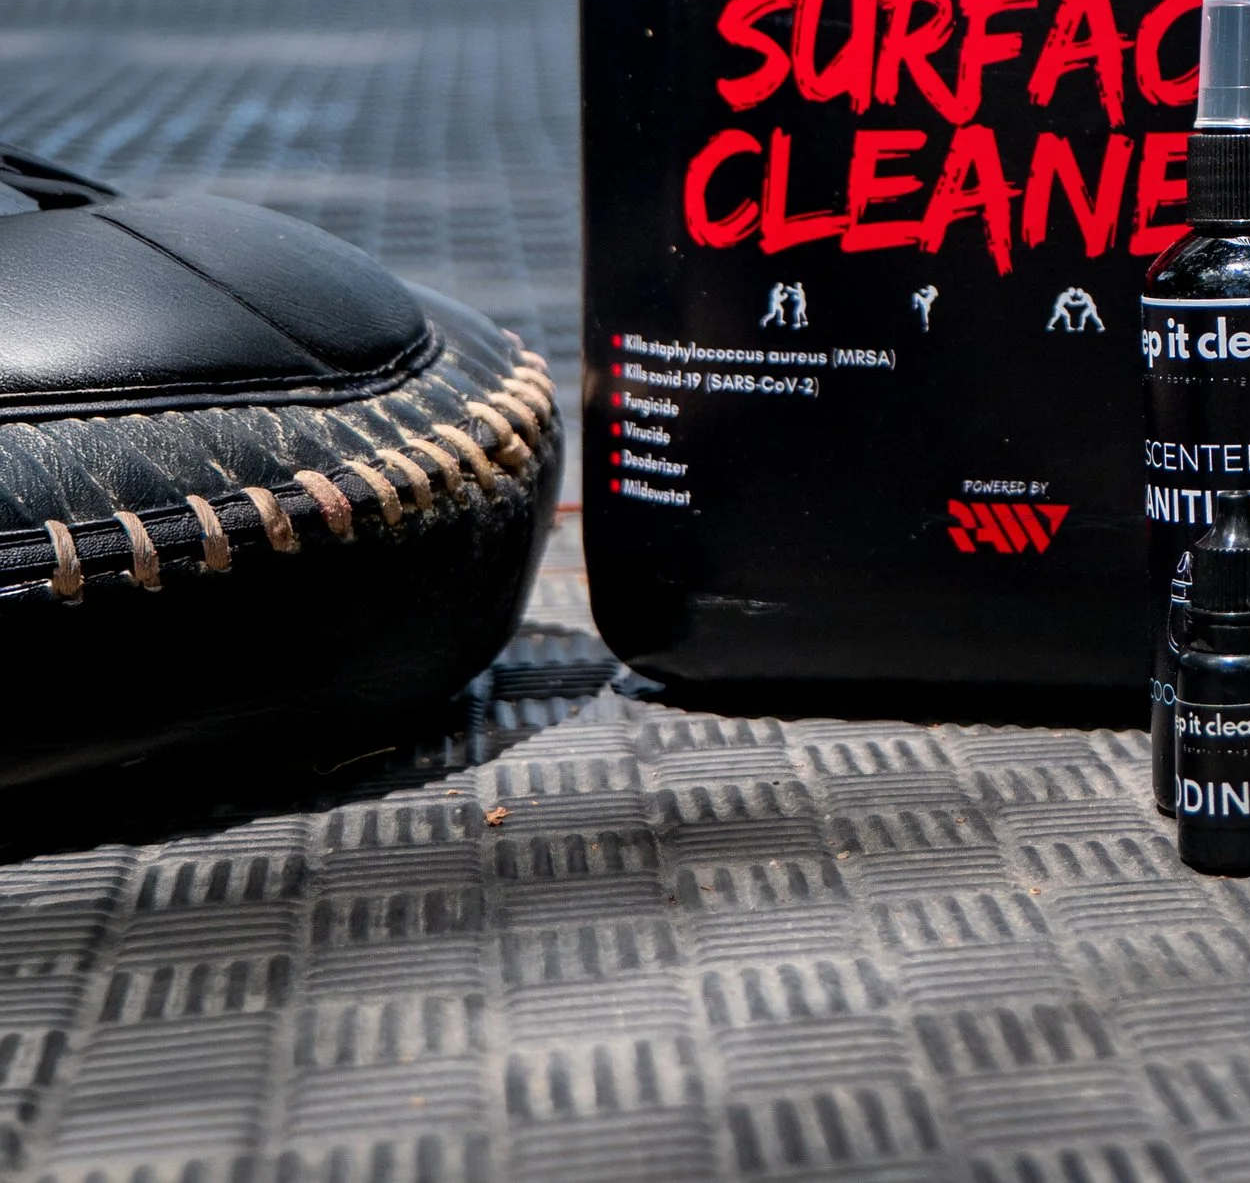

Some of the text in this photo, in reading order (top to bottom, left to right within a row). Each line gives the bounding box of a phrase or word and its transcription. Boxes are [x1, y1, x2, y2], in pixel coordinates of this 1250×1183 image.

[623, 333, 896, 370] Kills staphylococcus aureus (MRSA)
[1167, 318, 1190, 359] it
[623, 362, 819, 398] Kills covid-19 (SARS-CoV-2)
[622, 391, 680, 418] Fungicide
[621, 420, 671, 446] Virucide
[621, 478, 692, 506] Mildewstat
[964, 479, 1050, 495] POWERED BY
[1189, 711, 1202, 736] it
